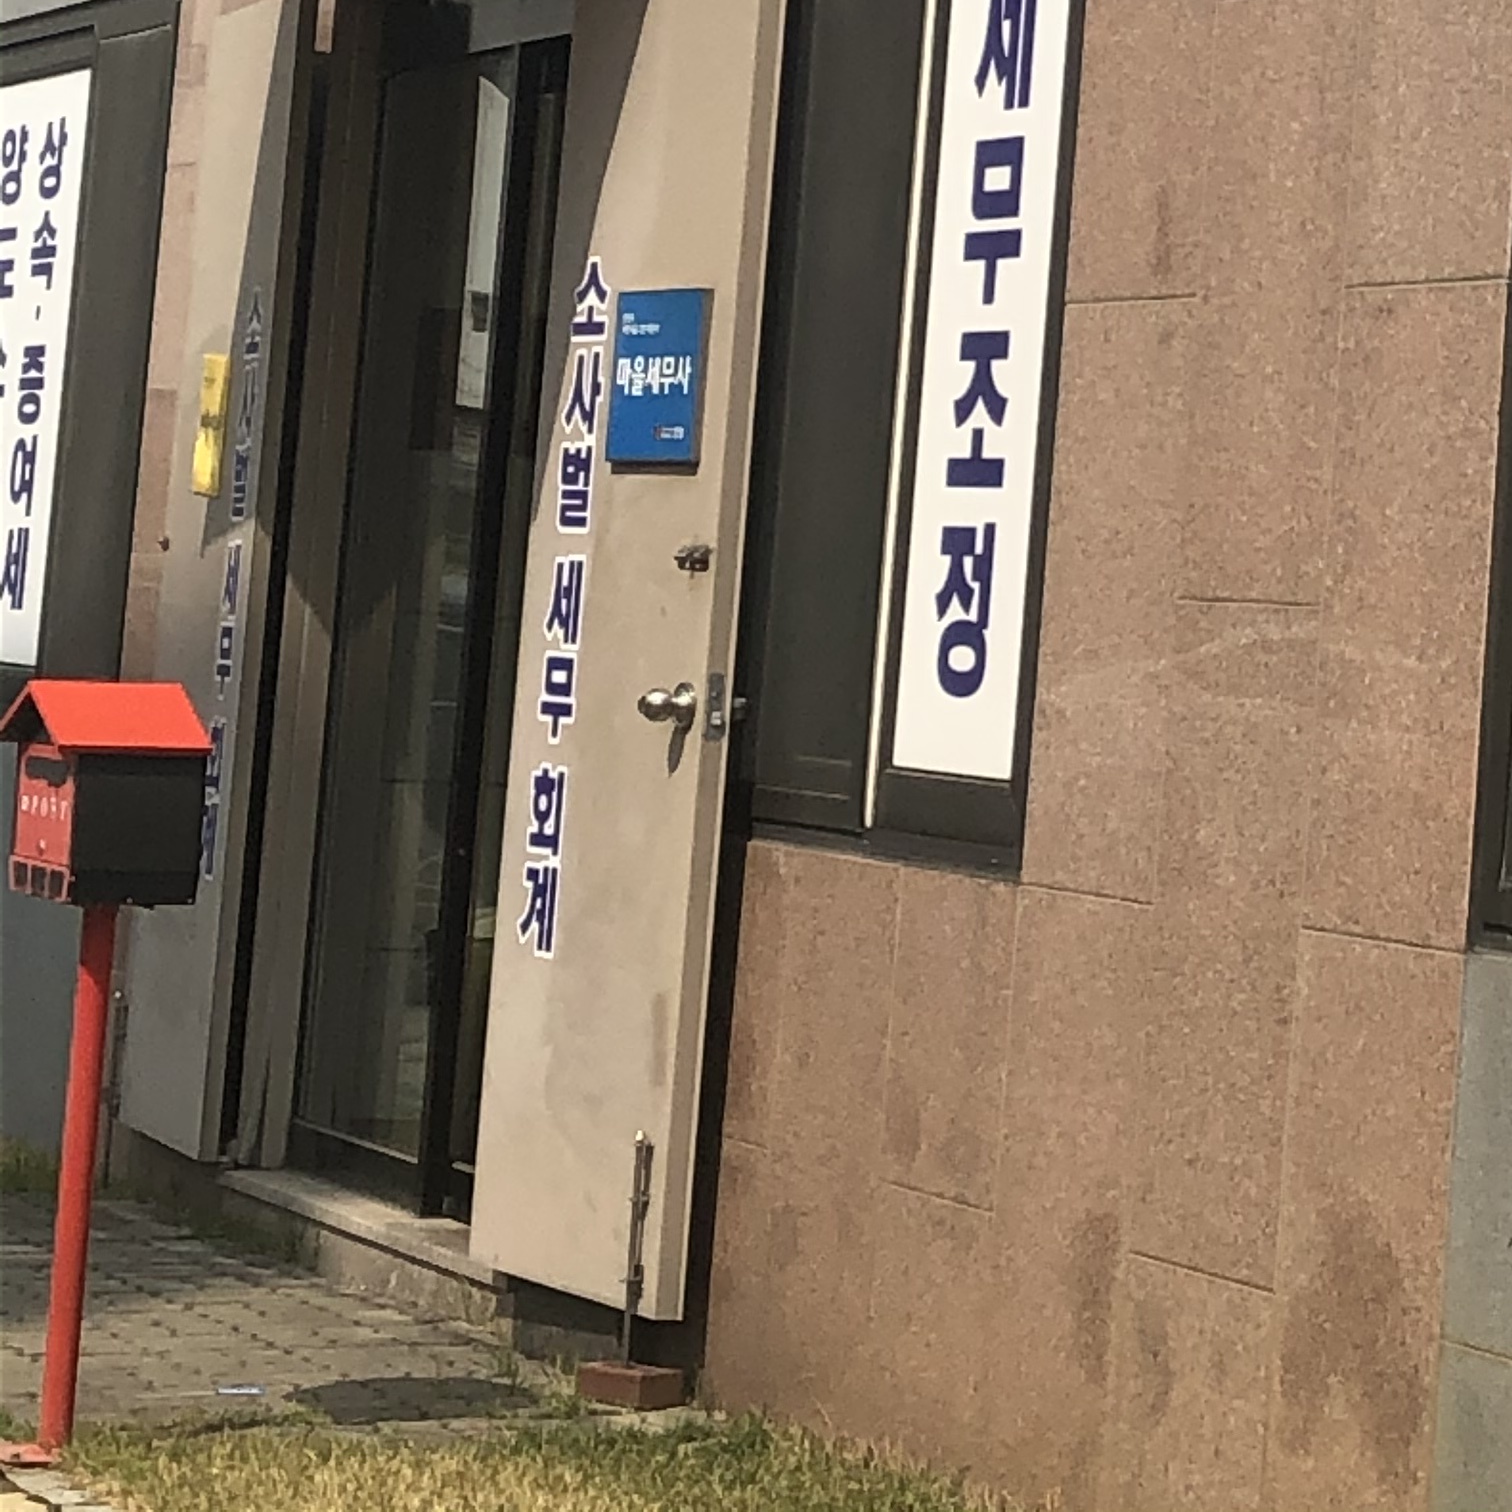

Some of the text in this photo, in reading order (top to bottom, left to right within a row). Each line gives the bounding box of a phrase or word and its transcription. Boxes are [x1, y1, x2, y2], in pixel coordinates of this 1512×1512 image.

[516, 258, 609, 958] 소사벌 세무 회계
